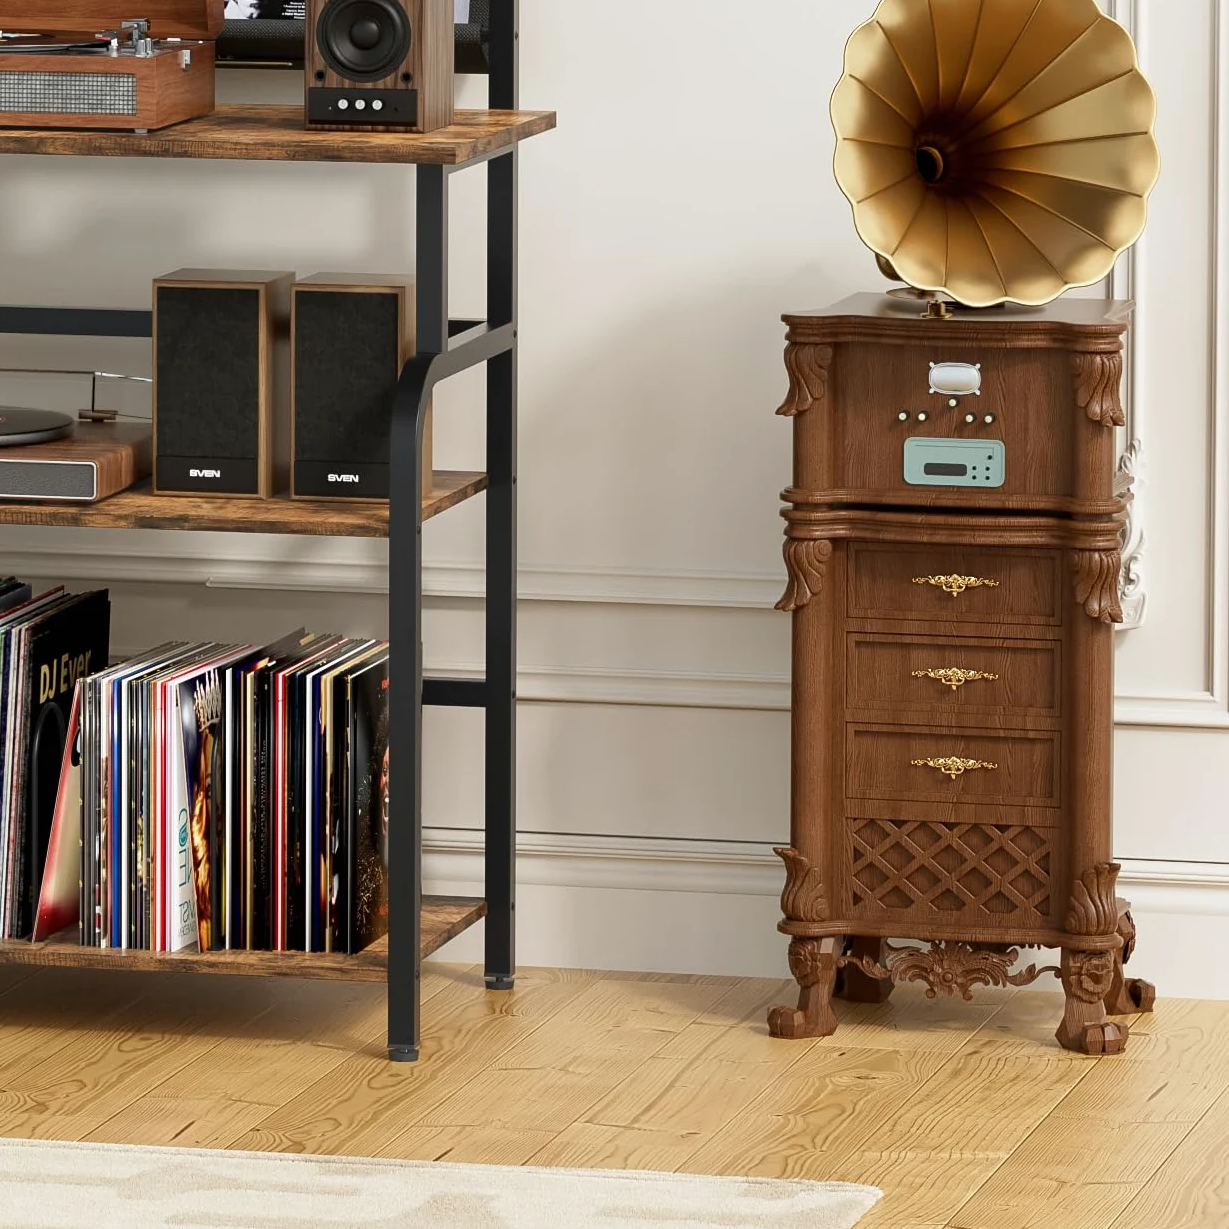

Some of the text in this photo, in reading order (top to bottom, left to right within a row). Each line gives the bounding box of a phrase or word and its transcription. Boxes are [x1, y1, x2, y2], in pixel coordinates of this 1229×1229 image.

[189, 469, 221, 478] SVEN
[327, 474, 359, 483] SVEN
[39, 658, 58, 705] DJ
